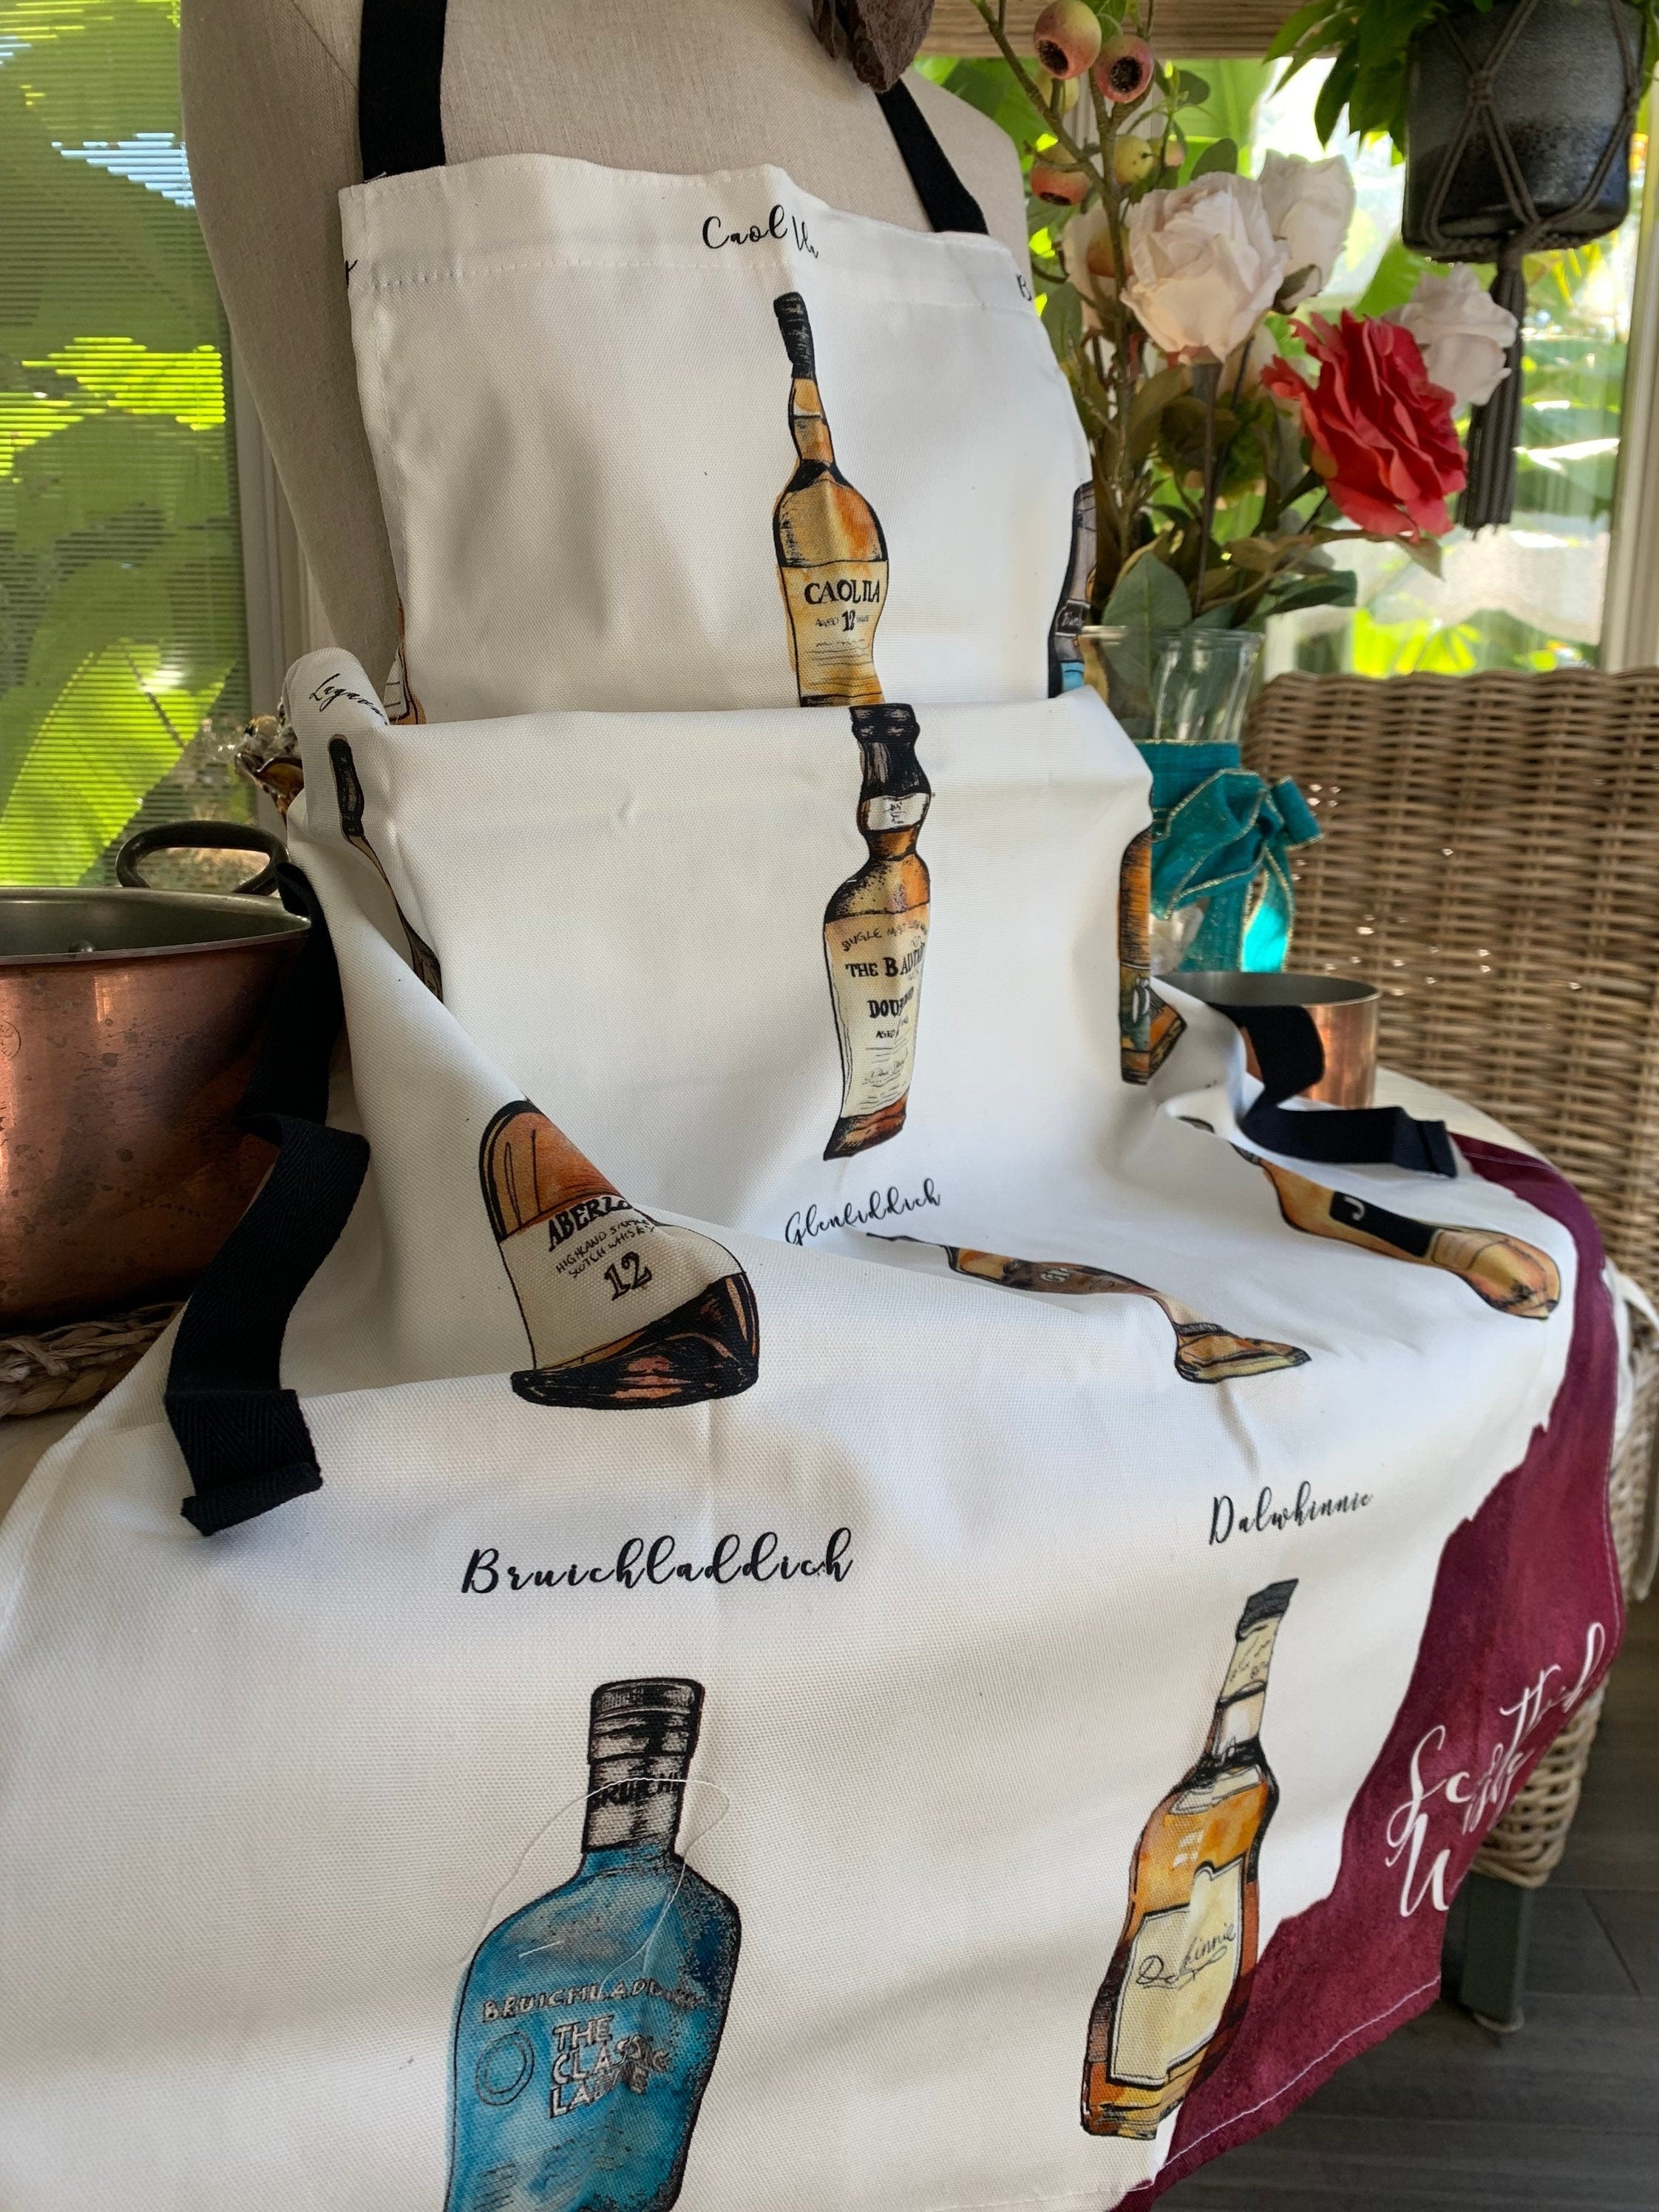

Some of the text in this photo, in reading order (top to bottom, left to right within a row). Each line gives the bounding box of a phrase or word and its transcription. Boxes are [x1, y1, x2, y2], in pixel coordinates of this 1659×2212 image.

[845, 963, 879, 977] THE
[556, 1231, 608, 1274] HIGHLAND
[603, 1251, 654, 1301] 12
[1209, 1480, 1375, 1545] Dalwhinnie
[461, 1527, 854, 1594] Bruichladdich
[552, 2013, 615, 2053] THE
